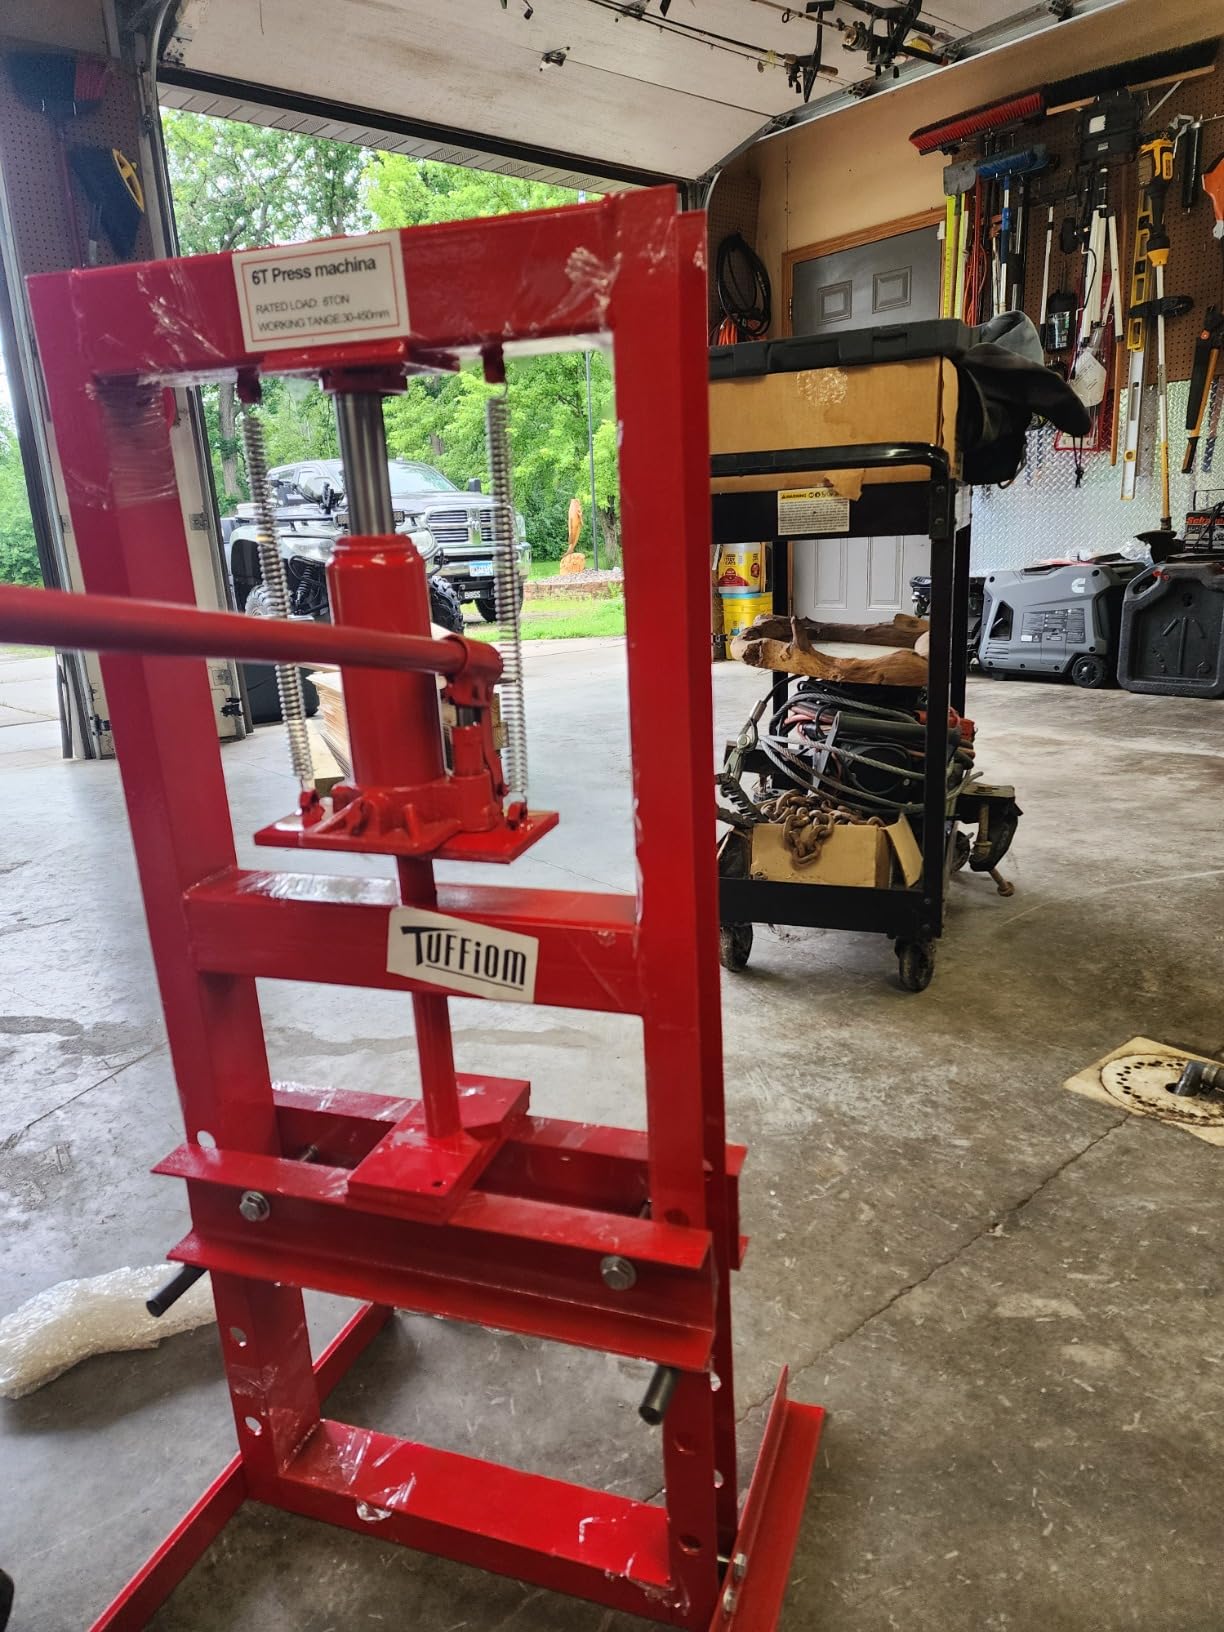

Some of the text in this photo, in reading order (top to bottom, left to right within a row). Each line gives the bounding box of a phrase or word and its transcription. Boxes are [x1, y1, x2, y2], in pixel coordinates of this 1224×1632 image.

[252, 256, 377, 285] 6T Press machina
[255, 301, 289, 314] RATED
[257, 319, 306, 332] WORKING
